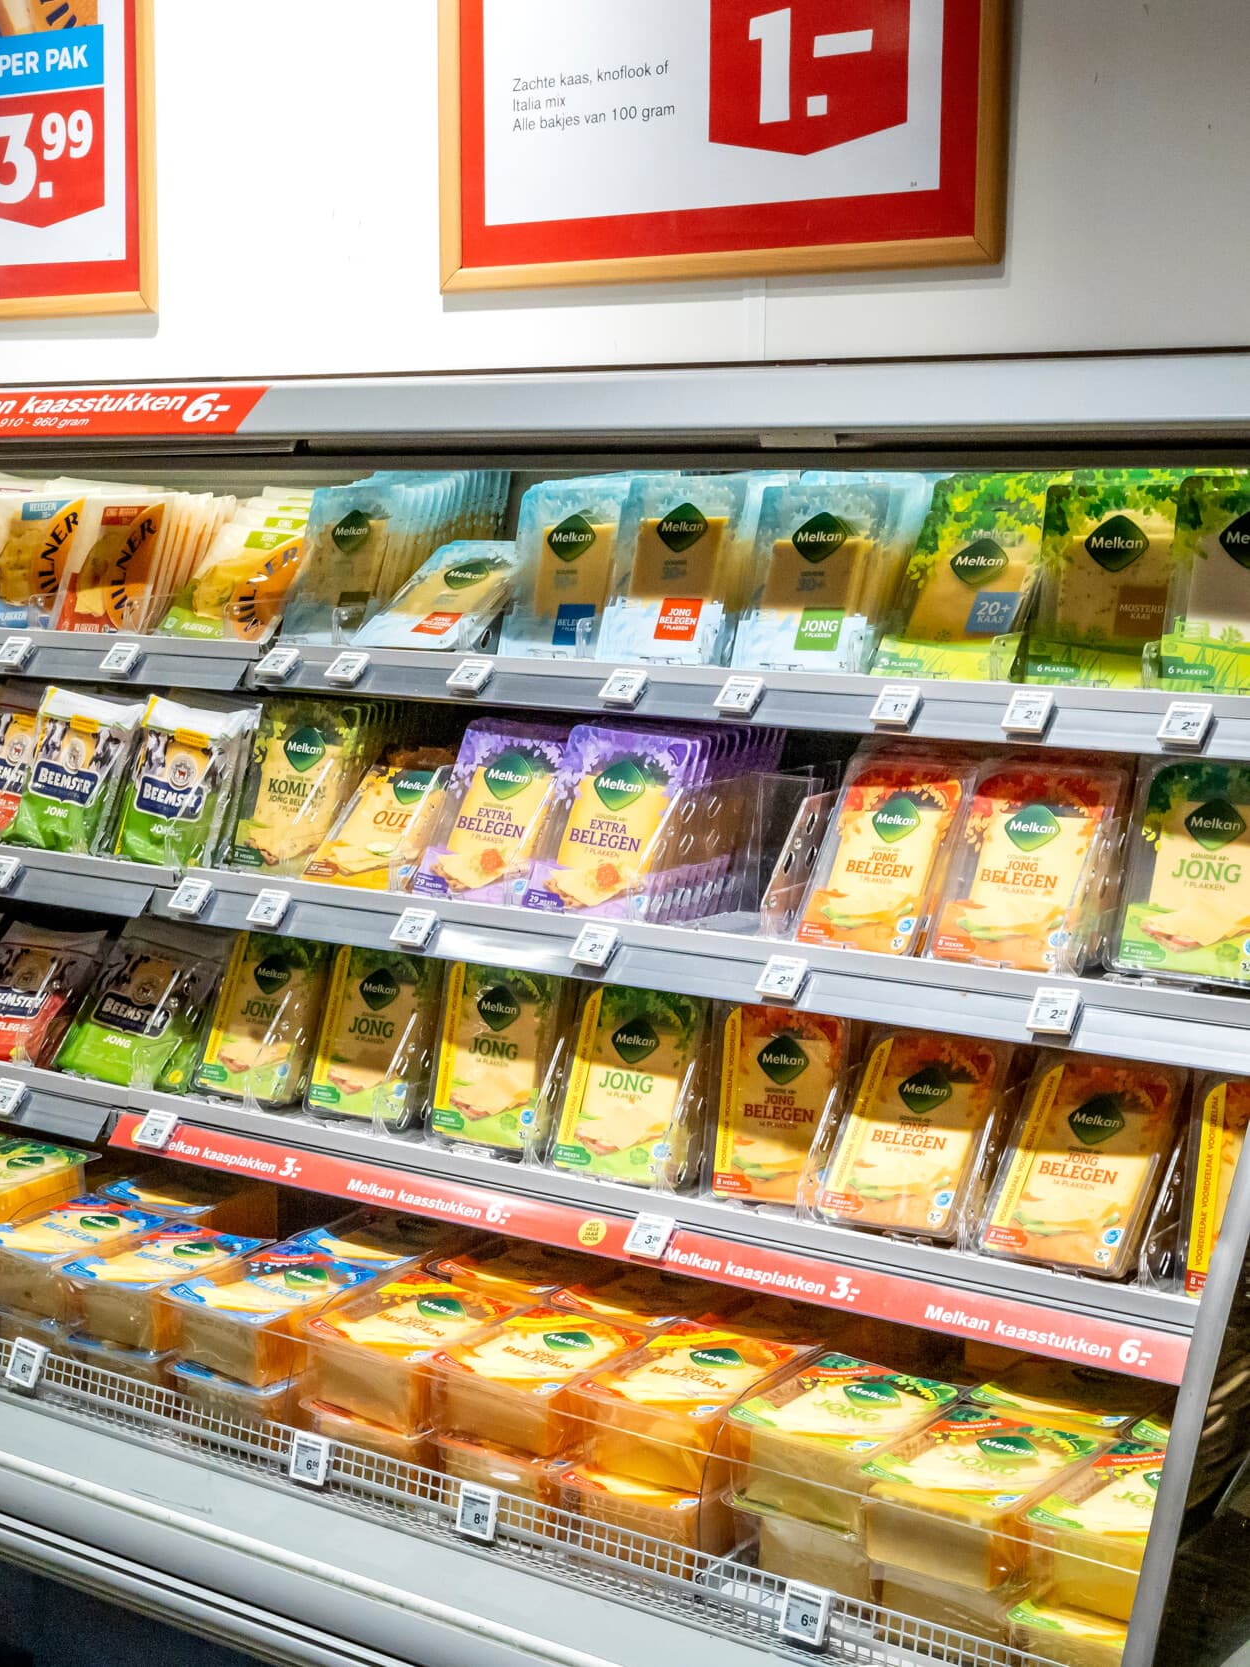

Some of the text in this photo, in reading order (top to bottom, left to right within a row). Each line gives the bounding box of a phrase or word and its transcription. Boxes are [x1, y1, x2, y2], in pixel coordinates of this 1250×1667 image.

[45, 44, 89, 72] PAK
[512, 60, 670, 93] Zachte kaas, knoflook of
[512, 94, 566, 112] Italia mix
[512, 102, 676, 132] Alle bakjes van 100 gram
[20, 393, 188, 414] kaasstukken
[32, 417, 57, 427] 960
[58, 417, 89, 429] gram
[335, 526, 368, 536] Melkan
[662, 521, 705, 533] Melkan
[552, 532, 592, 543] Melkan
[797, 531, 843, 543] Melkan
[1090, 536, 1144, 550] Melkan
[955, 555, 1004, 567] Melkan
[447, 570, 486, 580] Melkan
[667, 608, 692, 617] JONG
[975, 601, 1012, 616] 20+
[1119, 603, 1164, 615] MOSTERD
[659, 616, 697, 626] BELEGEN
[801, 620, 838, 632] JONG
[977, 615, 1006, 624] KAAS
[1044, 665, 1074, 673] PLAKKEN
[1176, 667, 1209, 677] PLAKKEN
[287, 741, 323, 756] Melkan
[488, 769, 529, 784] Melkan
[598, 777, 642, 793] Melkan
[44, 806, 68, 818] JONG
[476, 807, 513, 822] EXTRA
[457, 816, 526, 839] BELEGEN
[590, 819, 627, 835] EXTRA
[876, 813, 917, 827] Melkan
[1191, 815, 1242, 831] Melkan
[1009, 821, 1056, 835] Melkan
[569, 828, 641, 853] BELEGEN
[869, 850, 898, 862] JONG
[845, 859, 913, 878] BELEGEN
[1006, 859, 1039, 873] JONG
[1171, 858, 1242, 884] JONG
[416, 877, 425, 886] 29
[980, 868, 1058, 890] BELEGEN
[1190, 882, 1226, 892] PLAKKEN
[529, 895, 539, 903] 29
[257, 967, 289, 980] Melkan
[363, 982, 397, 996] Melkan
[481, 1001, 517, 1015] Melkan
[348, 1016, 395, 1039] JONG
[103, 1034, 131, 1048] JONG
[468, 1036, 518, 1060] JONG
[616, 1033, 656, 1048] Melkan
[762, 1052, 805, 1066] Melkan
[599, 1071, 654, 1094] JONG
[902, 1083, 948, 1097] Melkan
[764, 1093, 794, 1106] JONG
[743, 1104, 814, 1123] BELEGEN
[1072, 1112, 1120, 1128] Melkan
[897, 1121, 929, 1134] JONG
[871, 1130, 947, 1151] BELEGEN
[168, 1139, 200, 1158] elkan
[201, 1146, 277, 1176] kaasplakken
[1064, 1152, 1100, 1167] JONG
[1038, 1160, 1118, 1185] BELEGEN
[1194, 1095, 1219, 1266] VOORDEELPAK VOORDEELPAK VOORDEELPAK
[347, 1178, 395, 1201] Melkan
[398, 1189, 482, 1219] kaasstukken
[667, 1248, 721, 1272] Melkan
[724, 1261, 826, 1295] kaasplakken
[421, 1300, 463, 1318] Melkan
[377, 1311, 446, 1337] BELEGEN
[924, 1303, 991, 1332] Melkan
[994, 1318, 1112, 1359] kaasstukken
[548, 1333, 592, 1350] Melkan
[501, 1345, 575, 1370] BELEGEN
[694, 1350, 742, 1367] Melkan
[650, 1366, 728, 1390] BELEGEN
[848, 1385, 900, 1403] Melkan
[820, 1399, 882, 1422] JONG
[981, 1438, 1034, 1457] Melkan
[946, 1453, 1020, 1476] JONG
